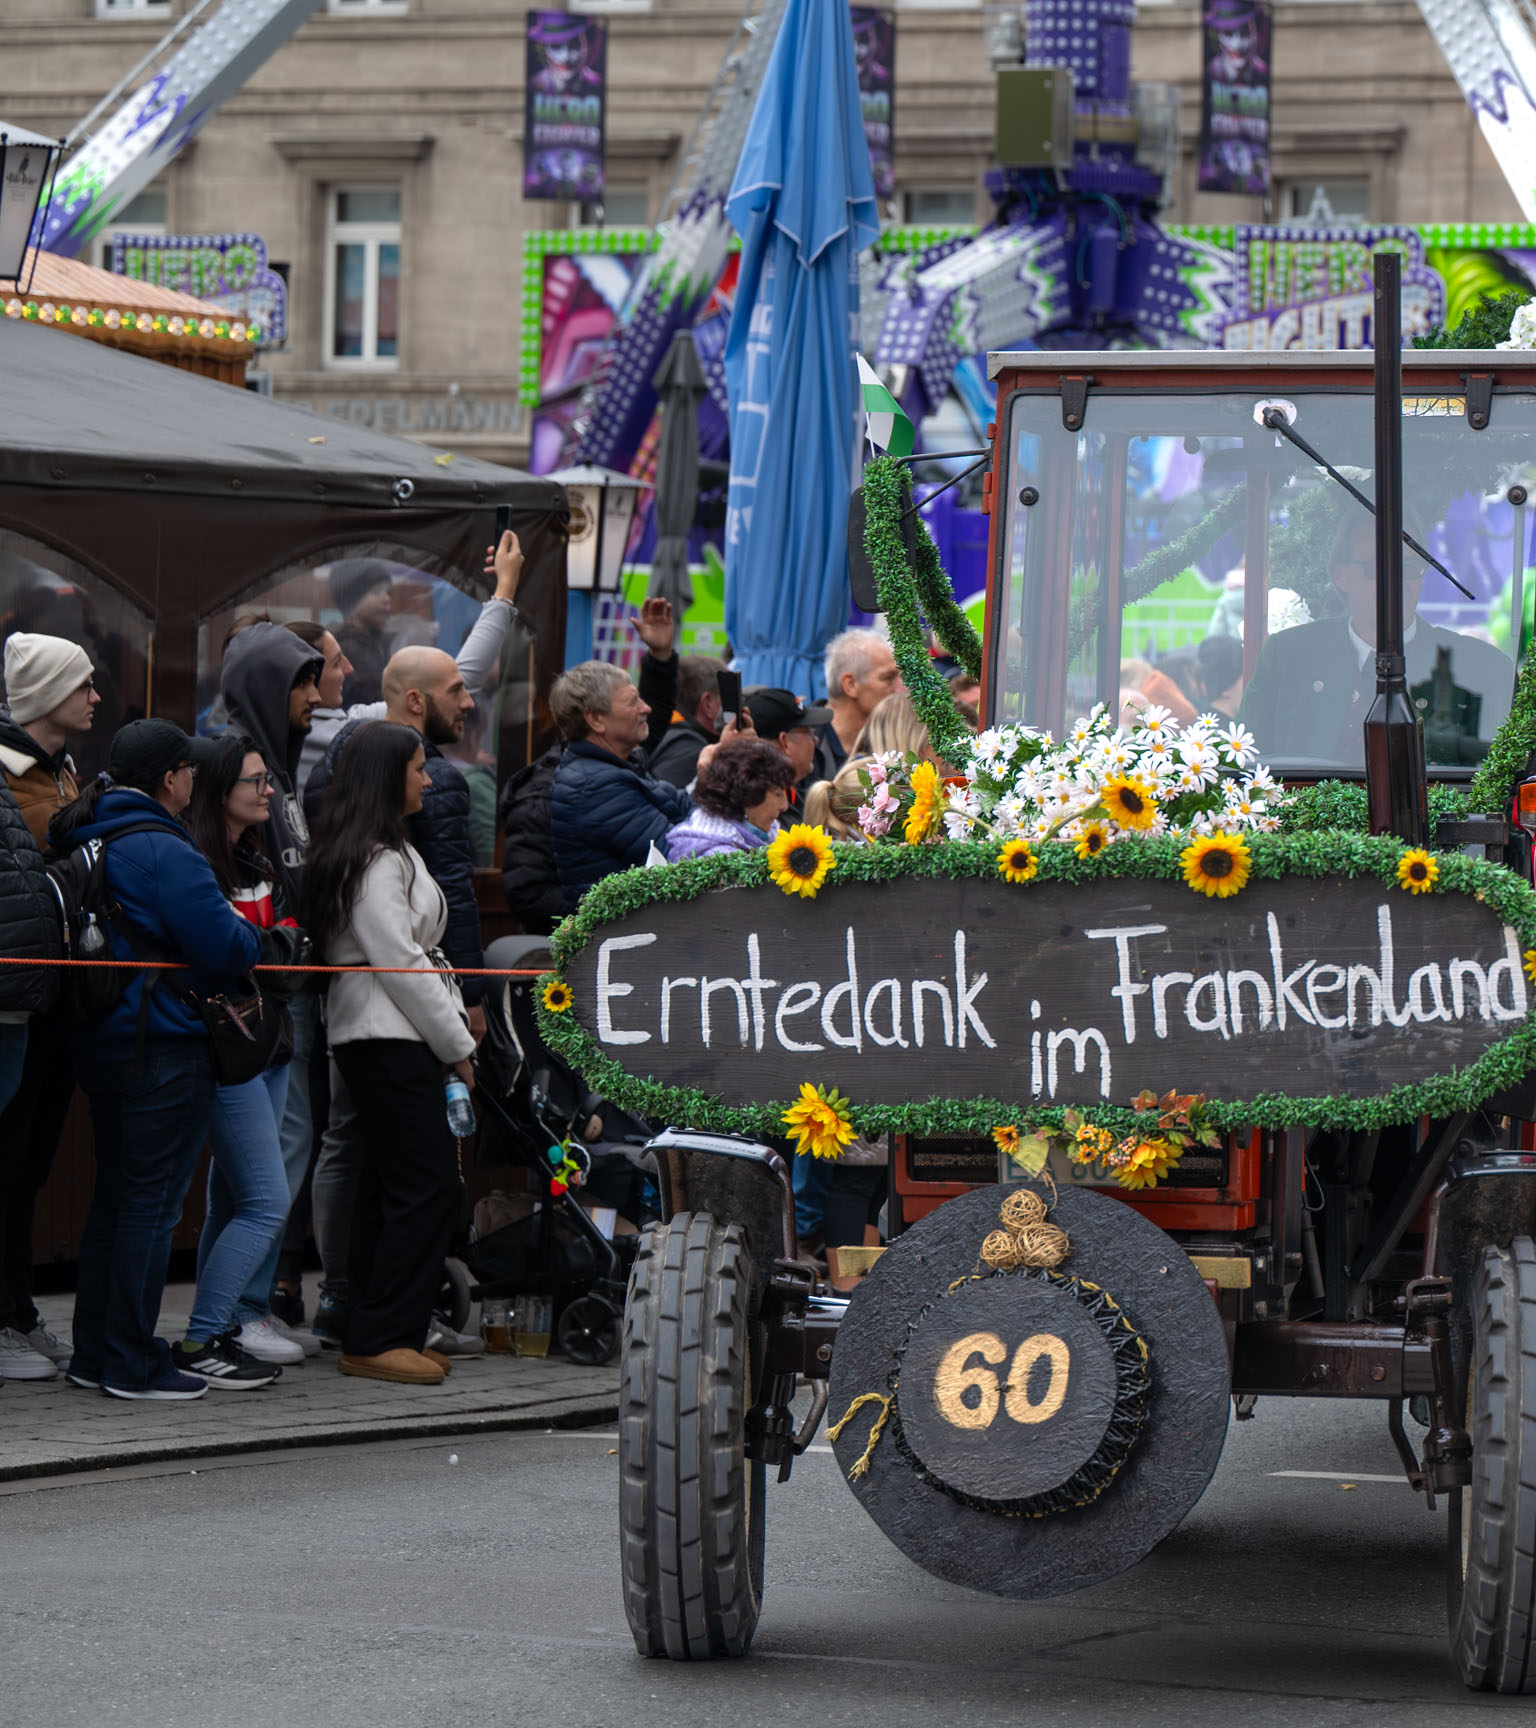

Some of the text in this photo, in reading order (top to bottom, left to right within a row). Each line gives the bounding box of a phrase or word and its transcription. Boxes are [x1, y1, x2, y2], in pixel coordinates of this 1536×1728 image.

[596, 904, 1527, 1100] Erntedank im Frankenland
[934, 1332, 1070, 1430] 60
